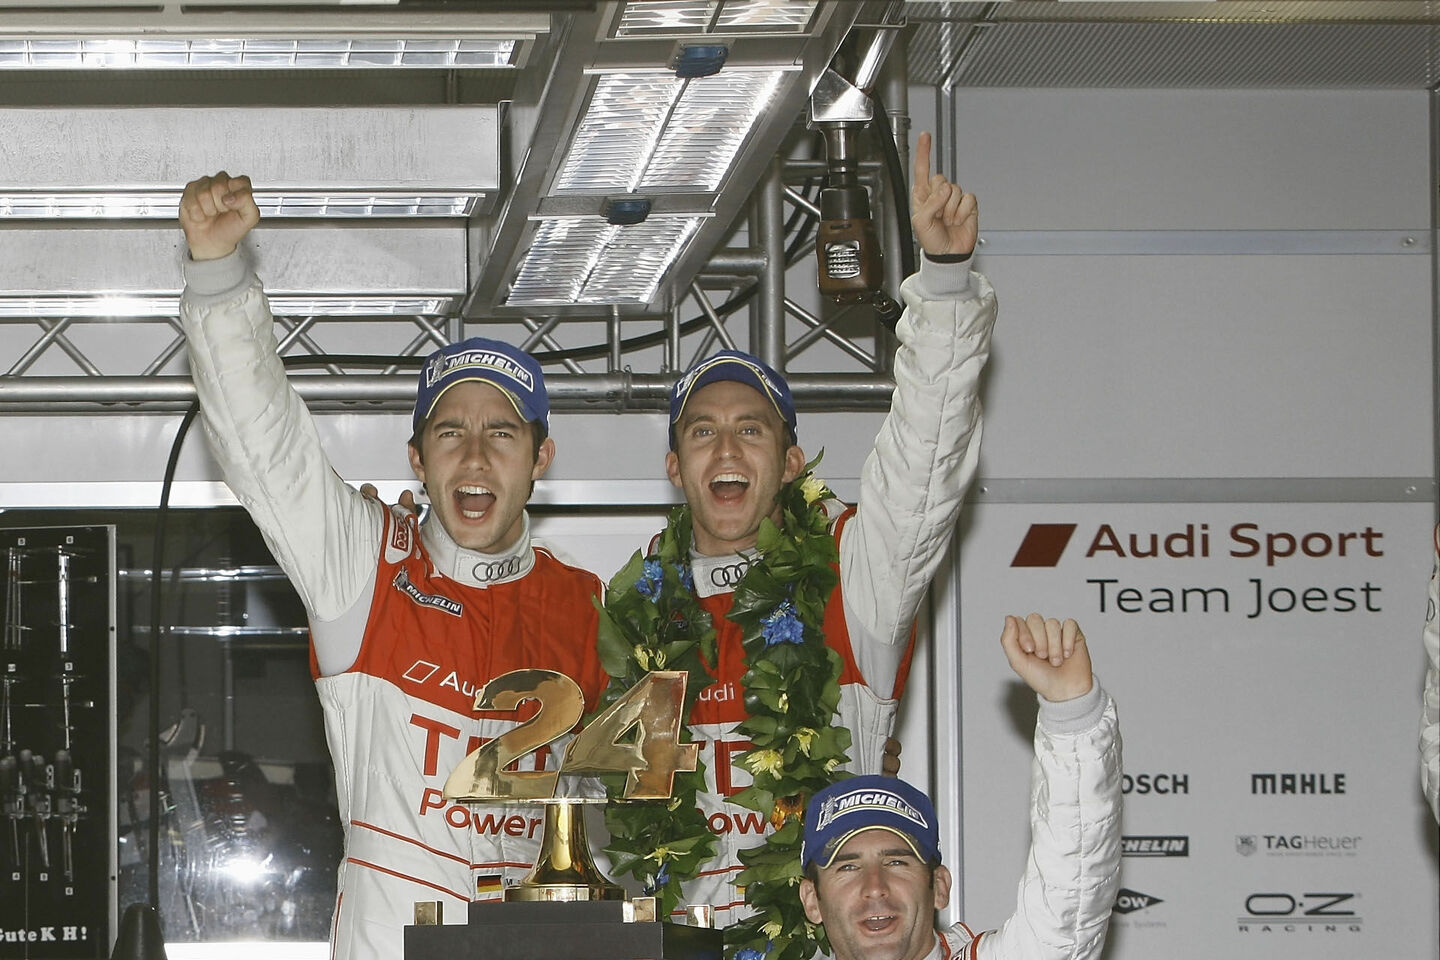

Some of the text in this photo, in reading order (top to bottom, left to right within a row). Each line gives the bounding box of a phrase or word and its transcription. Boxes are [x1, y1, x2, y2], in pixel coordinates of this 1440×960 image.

[449, 353, 530, 384] MICHELIN
[1085, 523, 1384, 567] Audi Sport
[406, 585, 461, 613] MICHELIN
[1086, 578, 1383, 619] Team Joest
[696, 682, 735, 702] udi
[443, 668, 700, 800] 24
[1121, 774, 1189, 794] OSCH
[1252, 774, 1346, 794] MAHLE
[419, 787, 543, 840] Power
[839, 794, 919, 820] MICHELIN
[1117, 896, 1149, 908] OW
[40, 927, 56, 942] K
